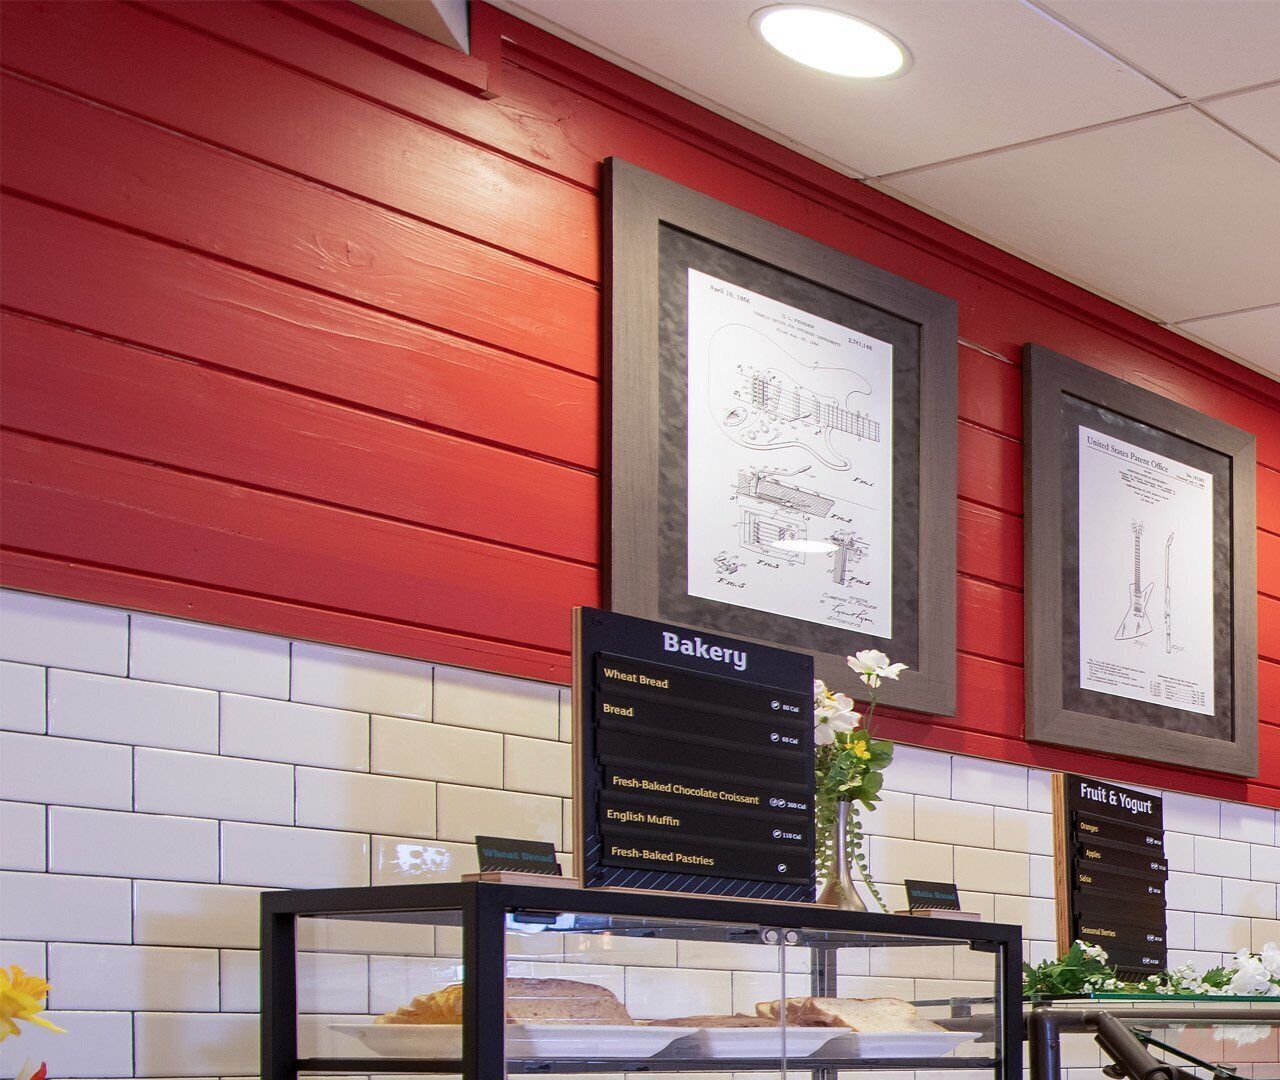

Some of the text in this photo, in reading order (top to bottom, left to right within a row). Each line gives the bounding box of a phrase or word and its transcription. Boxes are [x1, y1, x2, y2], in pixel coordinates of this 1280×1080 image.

[1086, 436, 1169, 473] United States Patent Office
[662, 632, 747, 671] Bakery
[604, 668, 668, 689] Wheat Bread
[603, 703, 634, 717] Bread
[612, 776, 760, 805] Fresh-Baked Chocolate Croissant
[1080, 783, 1152, 815] Fruit & Yogurt
[606, 809, 680, 826] English Muffin
[1080, 822, 1099, 833] Oranges
[483, 848, 554, 863] Wheat Bread
[611, 846, 714, 866] Fresh-Baked Pastries
[1086, 849, 1101, 859] Apples
[1079, 874, 1091, 883] Salsa
